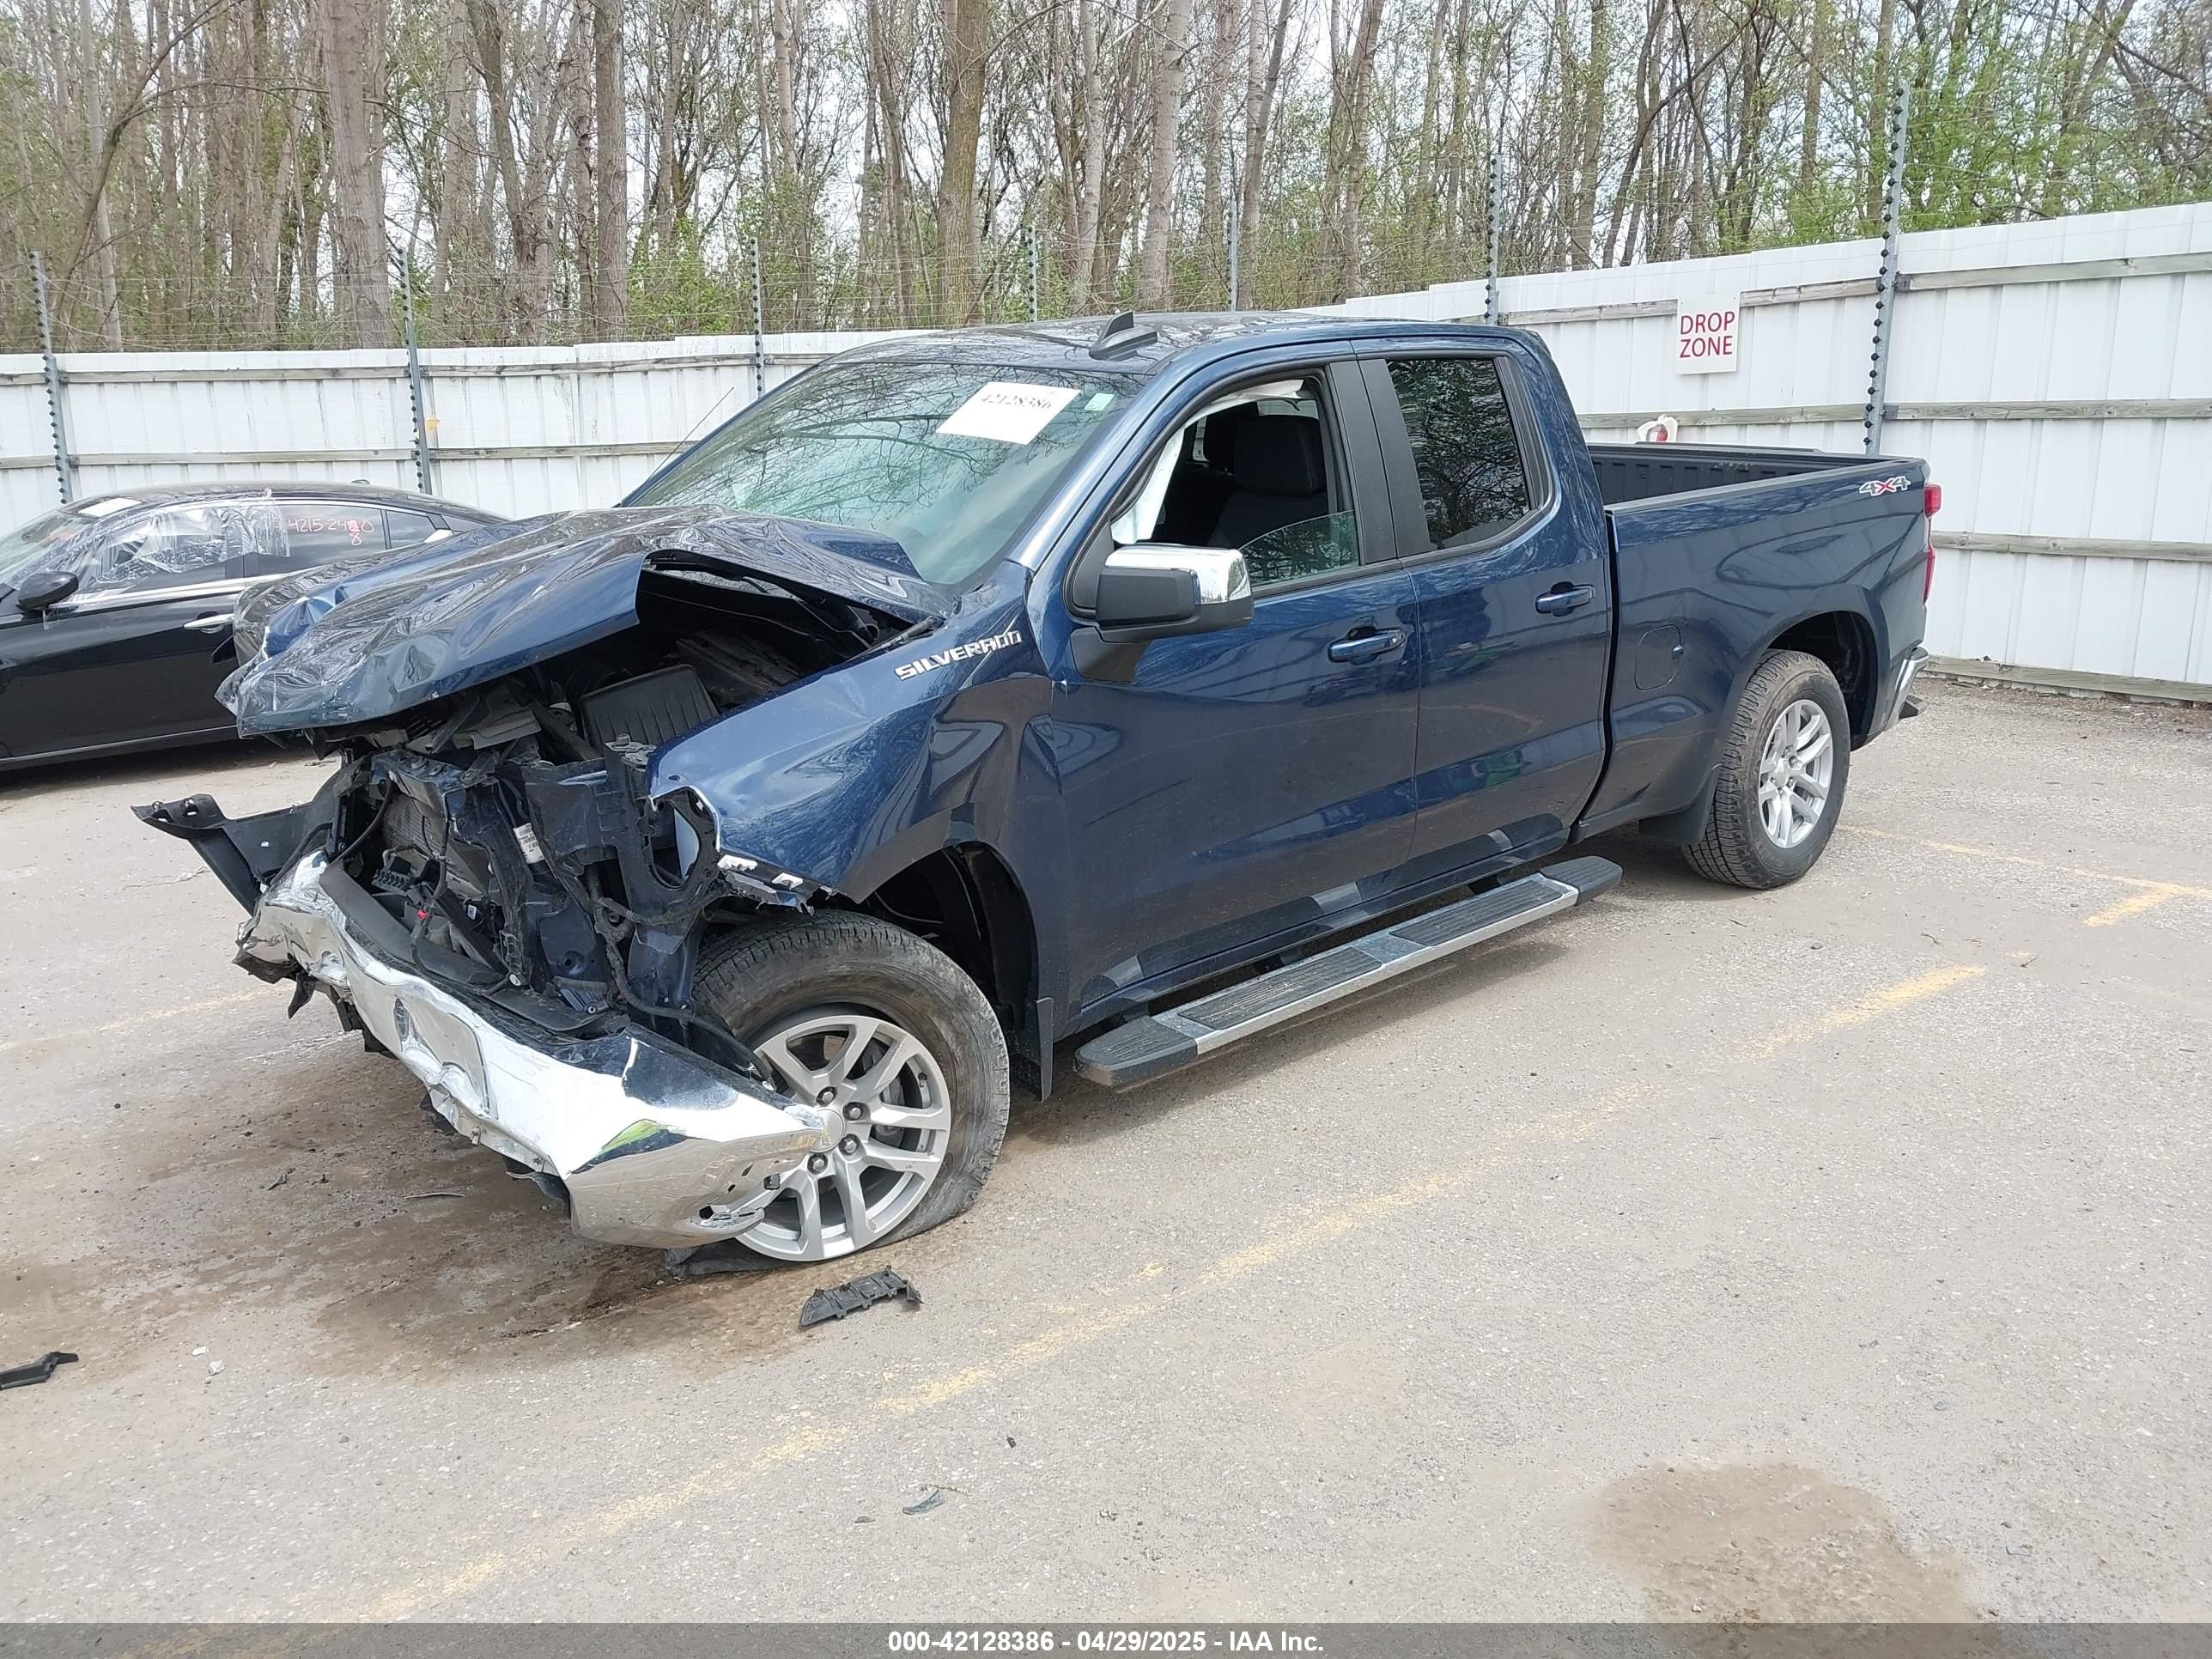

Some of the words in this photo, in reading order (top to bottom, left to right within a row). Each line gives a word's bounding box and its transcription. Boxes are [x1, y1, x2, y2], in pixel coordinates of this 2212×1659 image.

[1680, 311, 1735, 335] DROP
[1680, 335, 1733, 358] ZONE
[981, 393, 1052, 410] 42128386
[894, 630, 1022, 681] SILVERADO
